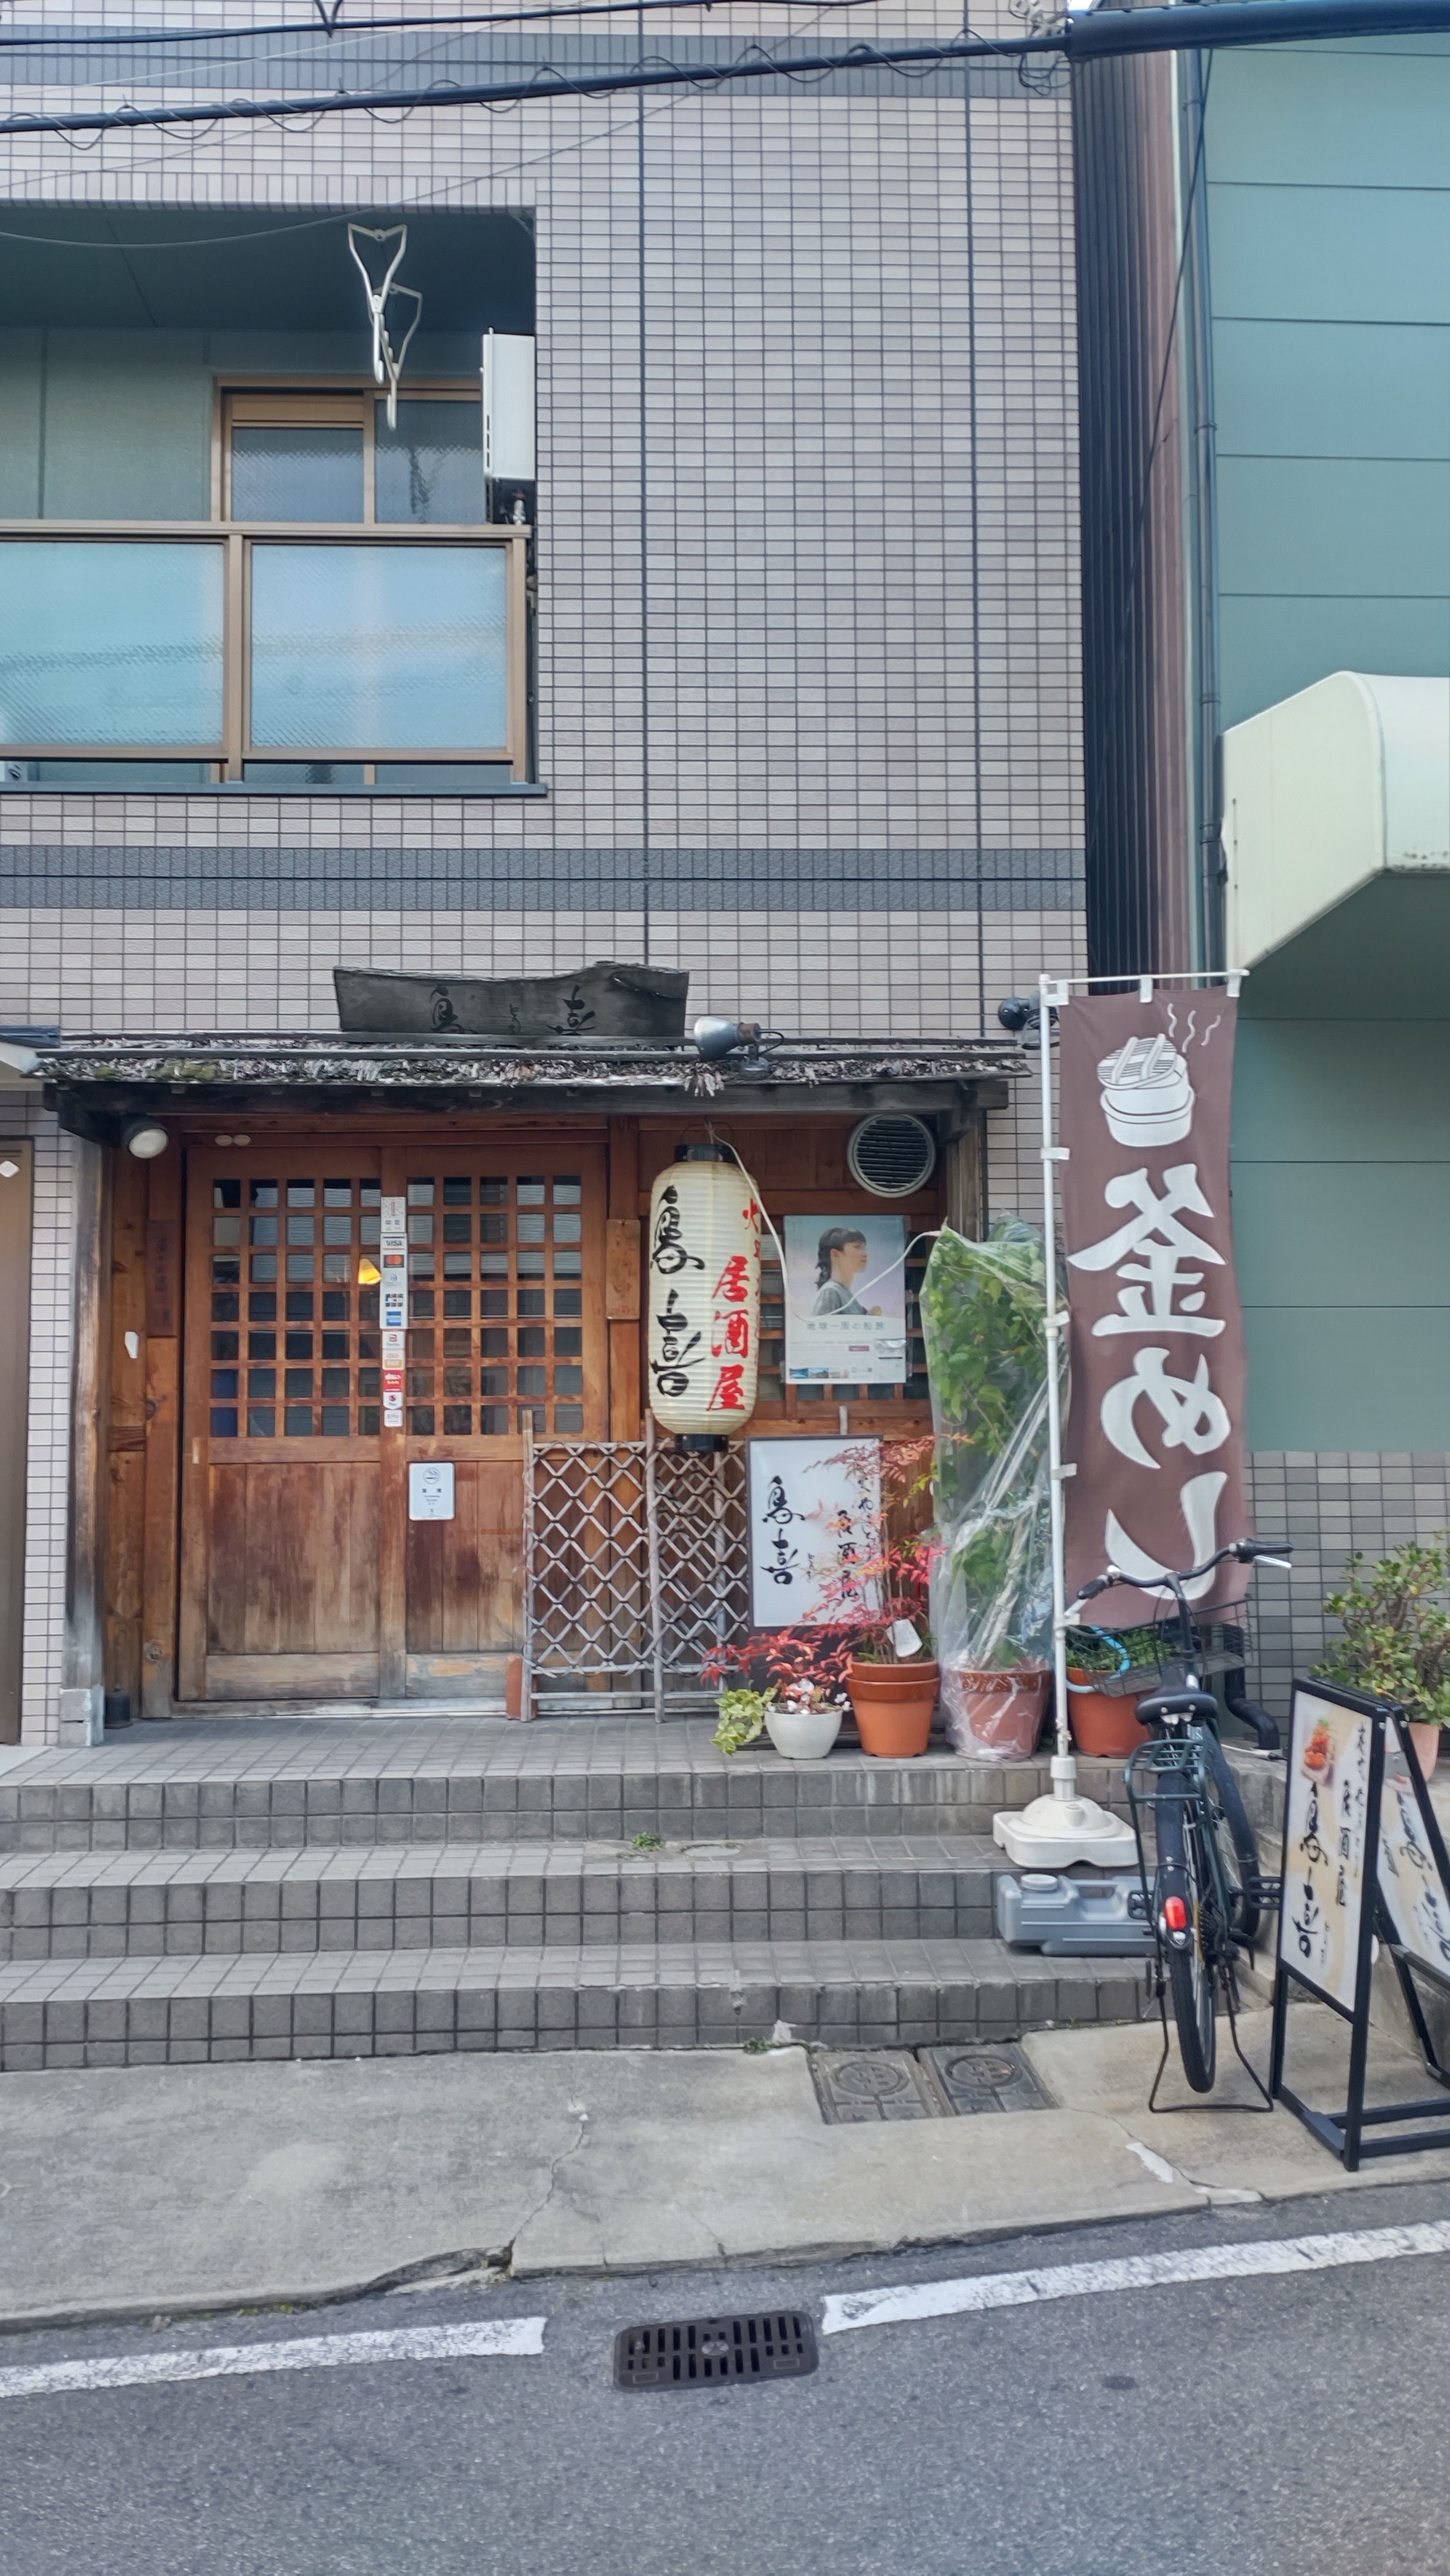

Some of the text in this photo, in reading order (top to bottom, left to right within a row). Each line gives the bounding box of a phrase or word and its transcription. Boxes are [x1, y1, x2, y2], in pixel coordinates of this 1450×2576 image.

[706, 1255, 750, 1411] 居酒屋
[1066, 1162, 1231, 1600] 釜めし
